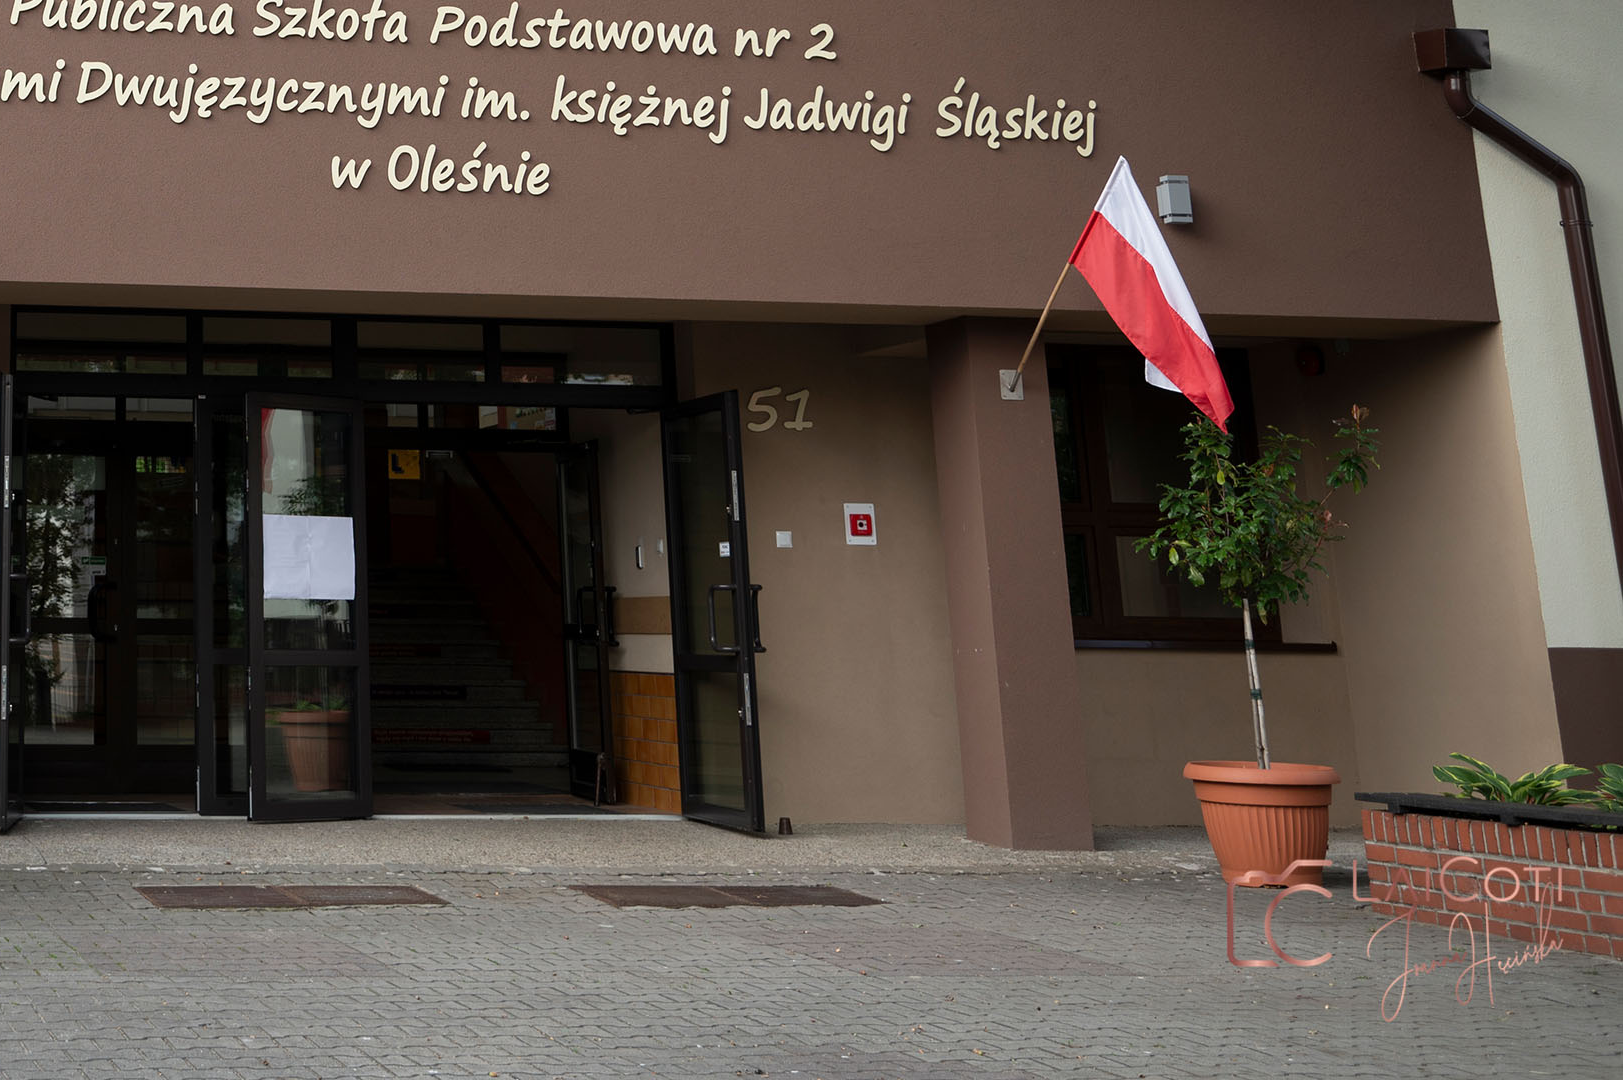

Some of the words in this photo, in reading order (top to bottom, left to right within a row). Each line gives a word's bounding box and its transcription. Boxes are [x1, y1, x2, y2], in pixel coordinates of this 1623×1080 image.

[429, 1, 718, 56] Podstawowa
[734, 27, 791, 58] nr
[804, 23, 837, 60] 2
[76, 58, 446, 130] Dwujęzycznymi
[460, 76, 530, 121] im.
[550, 74, 732, 144] księżnej
[743, 85, 911, 152] Jadwigi
[935, 76, 1097, 157] Śląskiej
[331, 155, 372, 189] w
[387, 141, 550, 195] Oleśnie
[747, 387, 813, 432] 51
